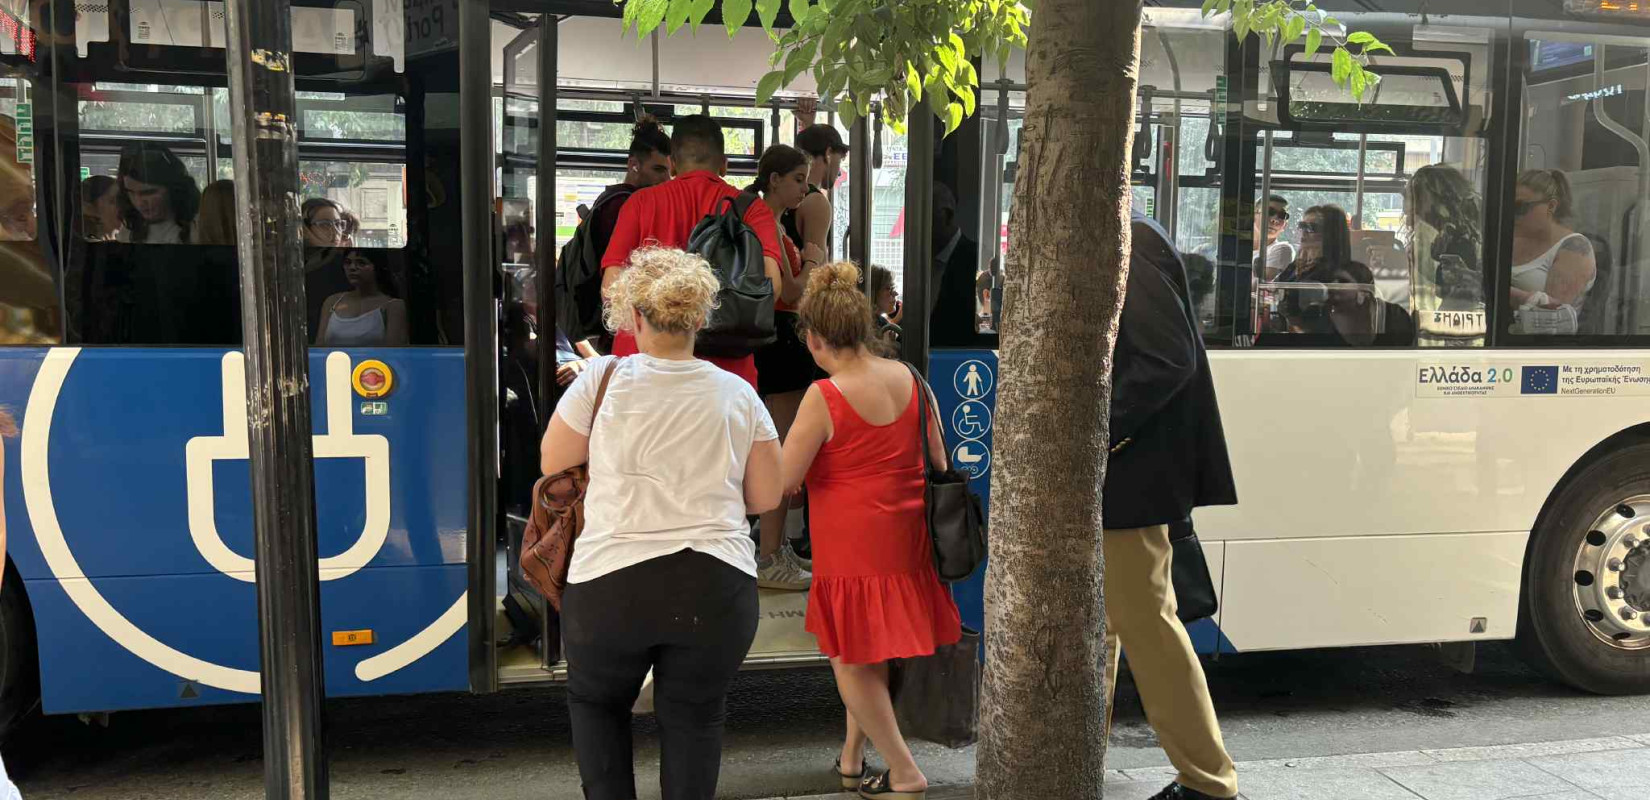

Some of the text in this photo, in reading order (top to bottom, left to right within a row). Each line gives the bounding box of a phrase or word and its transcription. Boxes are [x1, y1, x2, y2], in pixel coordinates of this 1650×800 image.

[1562, 365, 1641, 374] Με τη χρηματοδότηση
[1419, 366, 1513, 383] Ελλάδα 2.0
[1576, 375, 1621, 384] Ευρωπαϊκής
[1561, 387, 1616, 395] NextGenerationEU
